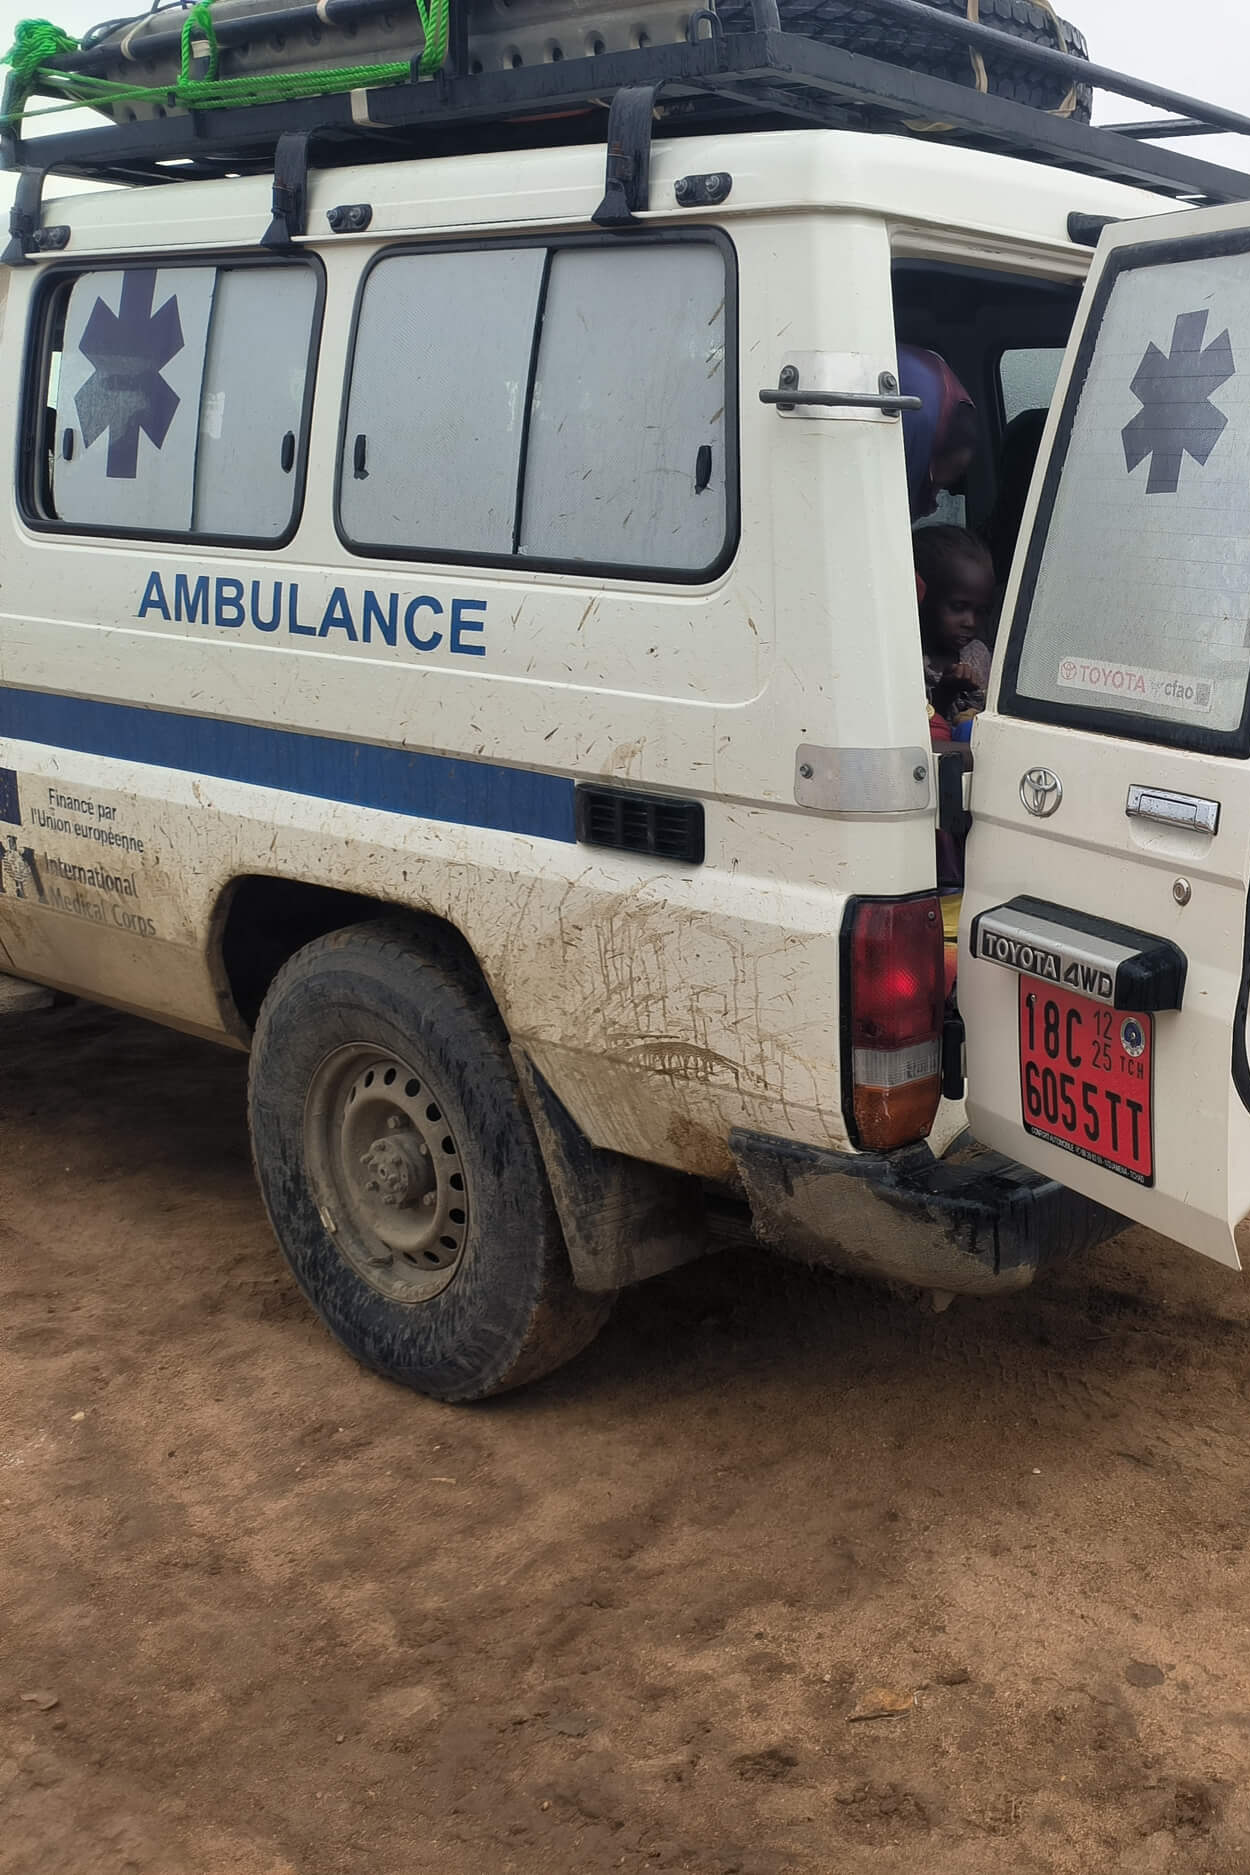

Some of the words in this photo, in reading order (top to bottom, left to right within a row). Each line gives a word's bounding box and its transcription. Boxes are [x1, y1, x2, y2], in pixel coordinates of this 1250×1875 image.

[137, 571, 488, 657] AMBULANCE
[1080, 664, 1146, 694] TOYOTA
[31, 808, 72, 834] l'Union
[74, 822, 144, 853] européenne
[97, 803, 117, 822] par
[44, 852, 139, 898] International
[49, 887, 107, 921] Medical
[112, 902, 157, 937] Corps
[986, 932, 1058, 979] TOYOTA
[1063, 962, 1113, 998] 4WD
[1026, 993, 1082, 1068] 18C
[1093, 1010, 1113, 1041] 12
[1092, 1040, 1112, 1071] 25
[1120, 1056, 1144, 1080] TCH
[1026, 1061, 1143, 1161] 6055TT
